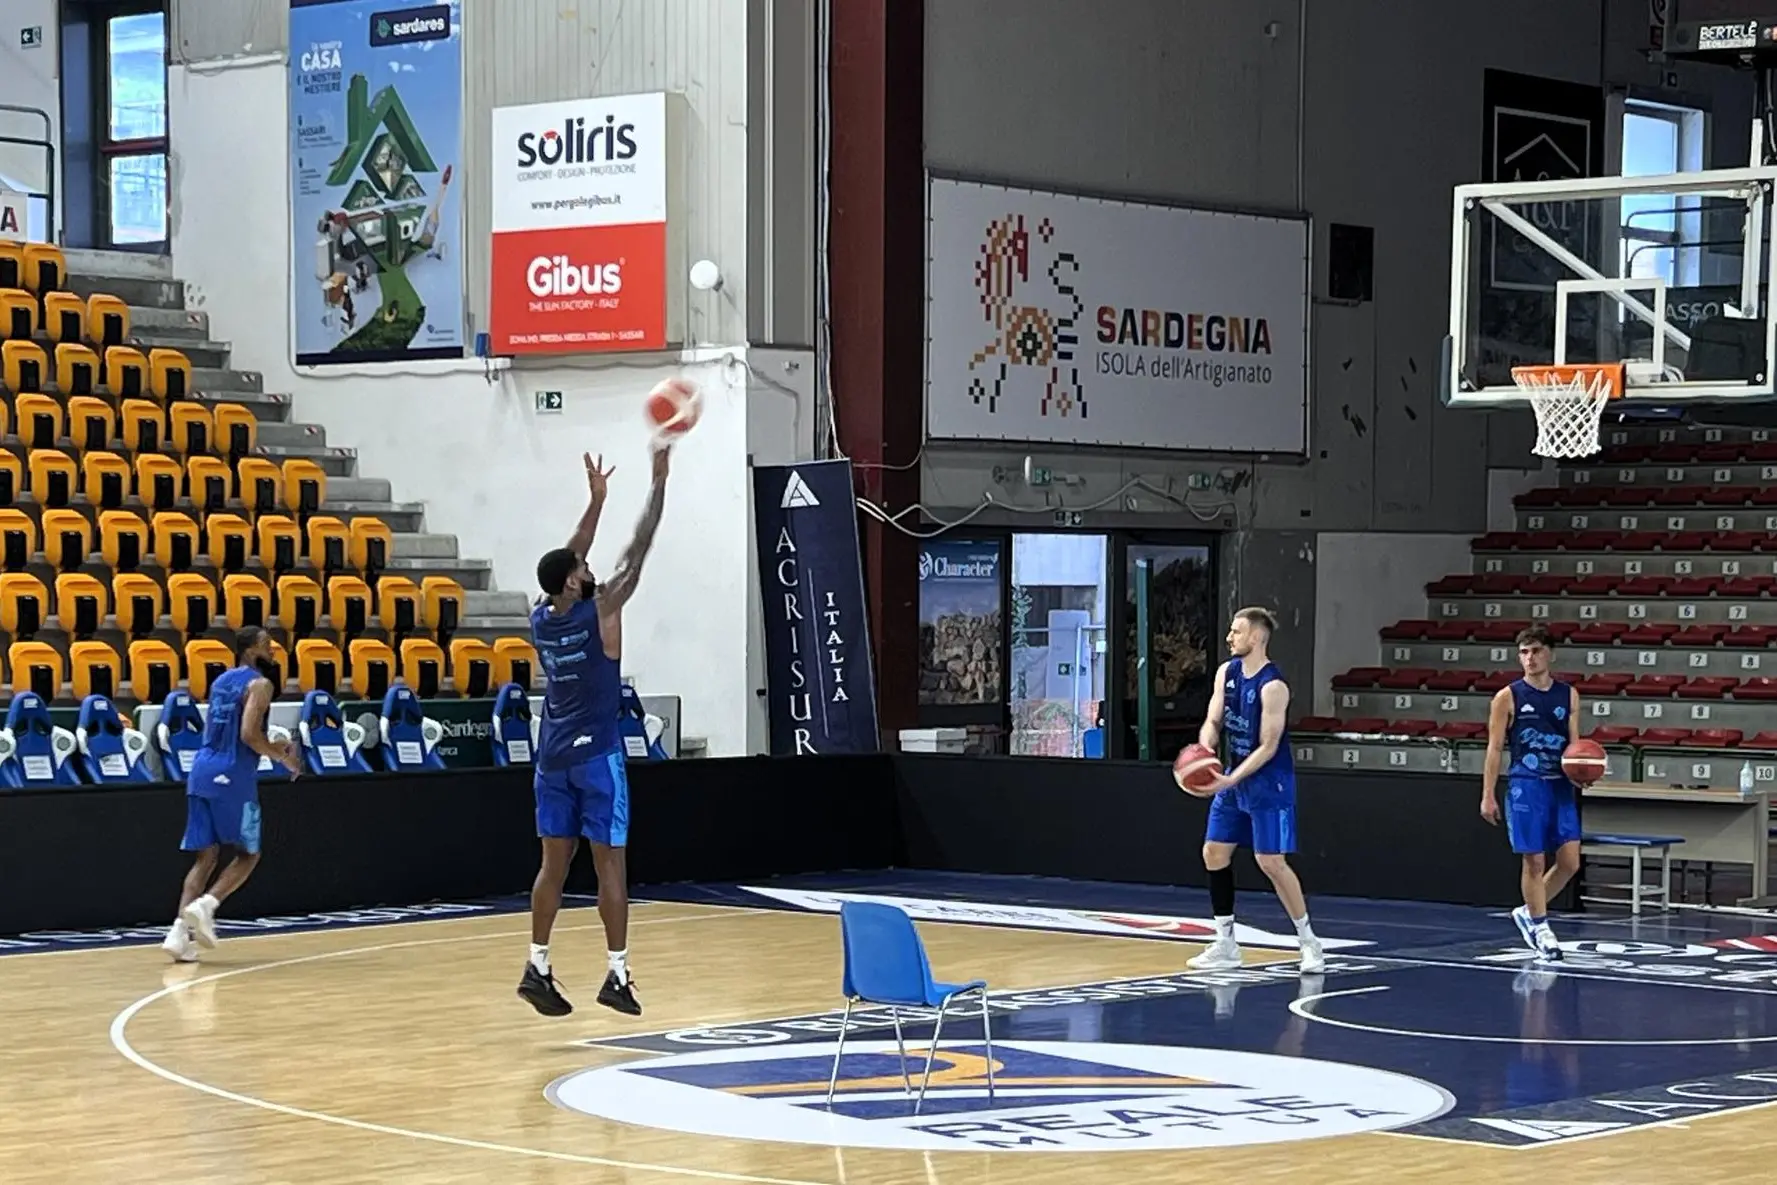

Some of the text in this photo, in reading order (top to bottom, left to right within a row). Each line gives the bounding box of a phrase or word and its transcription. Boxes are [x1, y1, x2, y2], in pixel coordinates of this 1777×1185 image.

[301, 49, 342, 72] CASA
[517, 114, 637, 168] soliris
[0, 206, 19, 232] A
[527, 255, 622, 297] Gibus
[1097, 306, 1272, 354] SARDEGNA
[1096, 352, 1272, 387] ISOLA dell'Artigianato
[934, 557, 994, 577] Character
[824, 592, 849, 702] ITALIA
[1758, 768, 1772, 780] 10
[904, 1094, 1353, 1138] REALE
[973, 1108, 1410, 1149] MUTUA
